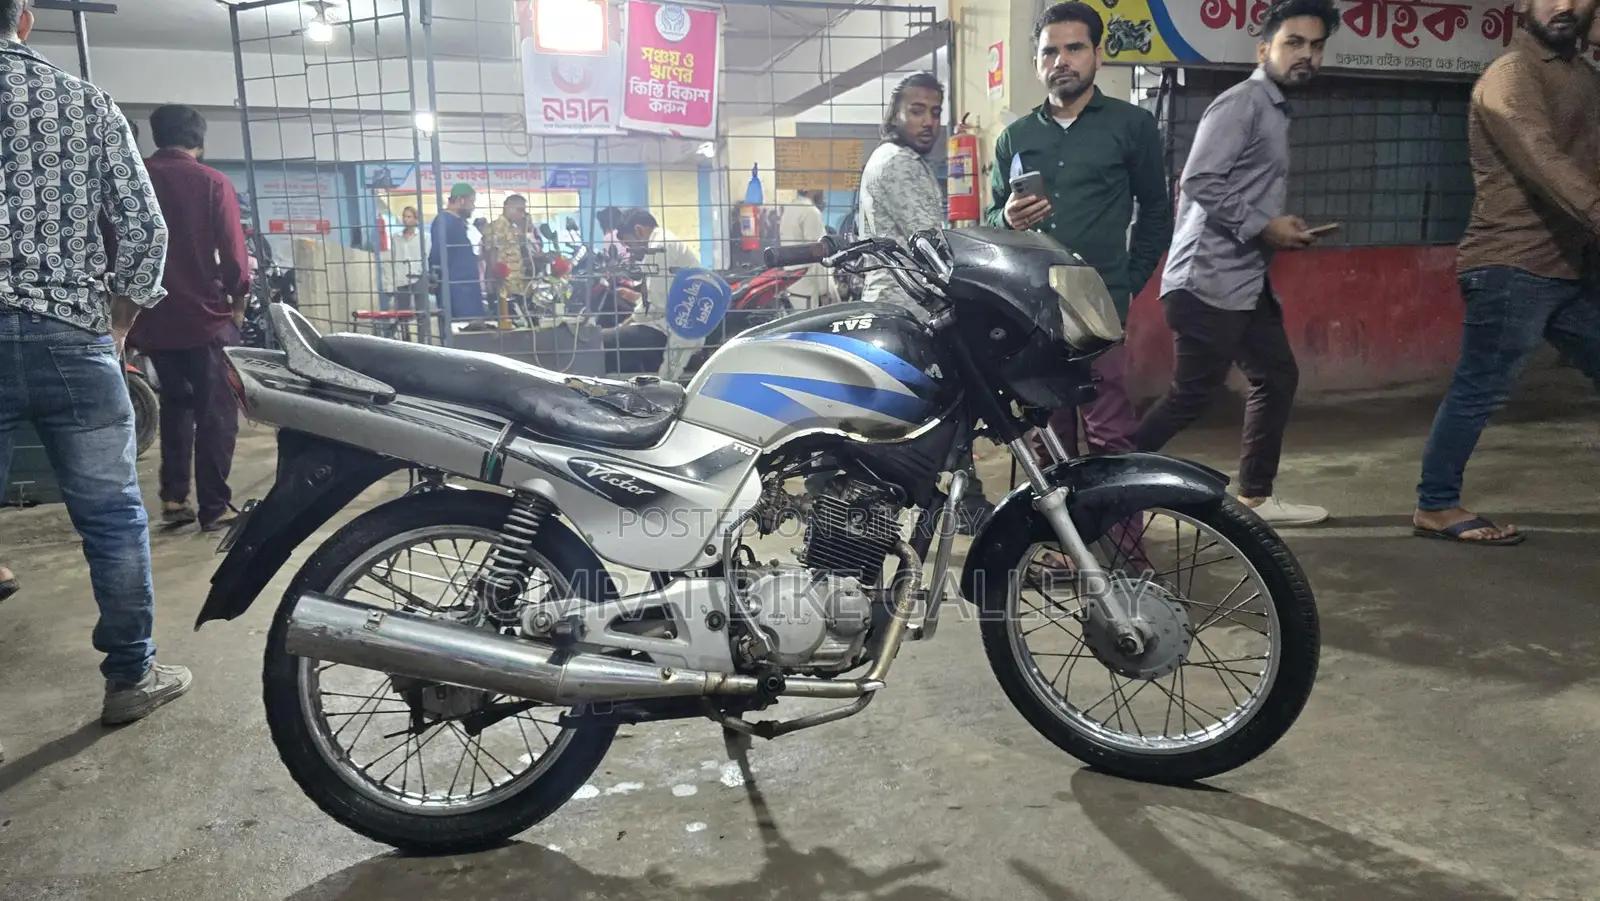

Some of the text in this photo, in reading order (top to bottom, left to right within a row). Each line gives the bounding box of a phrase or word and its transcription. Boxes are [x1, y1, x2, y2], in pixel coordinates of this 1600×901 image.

[641, 46, 694, 68] সঞ্চয় ও
[650, 64, 693, 83] ঋণের
[629, 77, 710, 103] কিস্তি বিকাশ
[542, 97, 609, 123] নগদ
[649, 98, 688, 116] করুন
[831, 317, 873, 333] TVS
[732, 442, 755, 456] TVS
[573, 458, 656, 495] Victor
